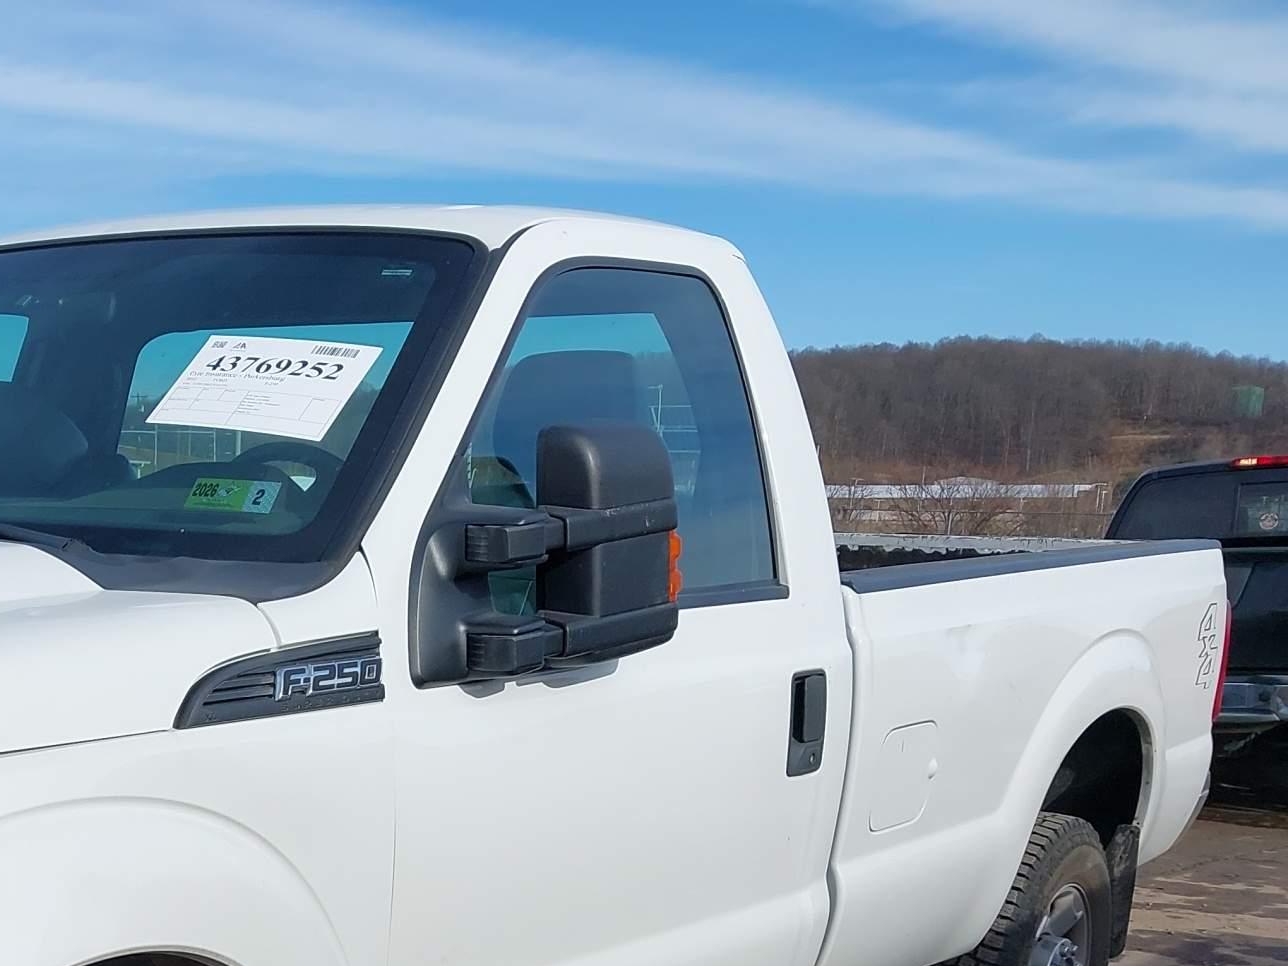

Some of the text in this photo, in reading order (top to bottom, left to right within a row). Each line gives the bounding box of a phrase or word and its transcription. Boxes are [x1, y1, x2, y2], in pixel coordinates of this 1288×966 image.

[206, 355, 344, 380] 43769252
[192, 483, 219, 497] 2026
[251, 489, 266, 506] 2
[1195, 602, 1218, 690] 4x4
[276, 656, 383, 700] F-250
